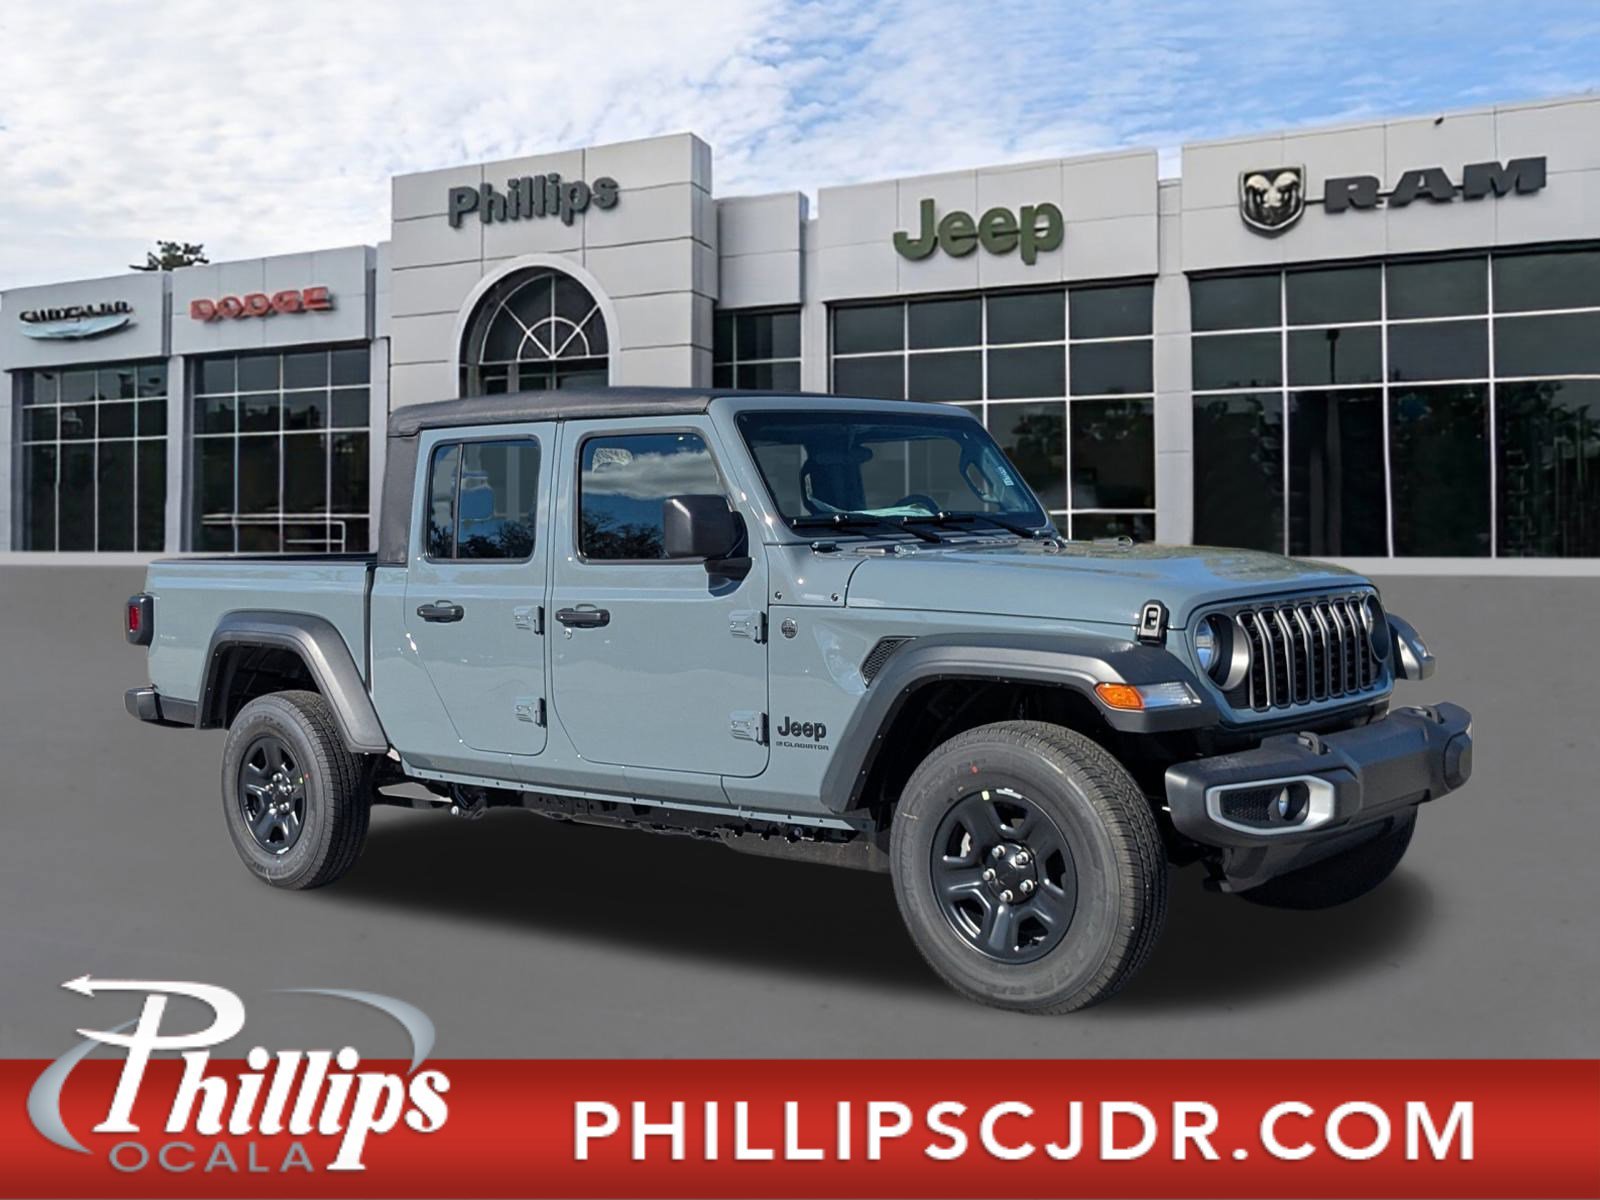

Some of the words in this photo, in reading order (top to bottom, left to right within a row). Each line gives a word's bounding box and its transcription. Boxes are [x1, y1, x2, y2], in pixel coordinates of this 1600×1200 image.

[448, 173, 619, 228] Phillips
[1324, 156, 1547, 214] RAM
[893, 198, 1064, 266] Jeep
[190, 286, 334, 323] DODGE
[777, 716, 827, 742] Jeep
